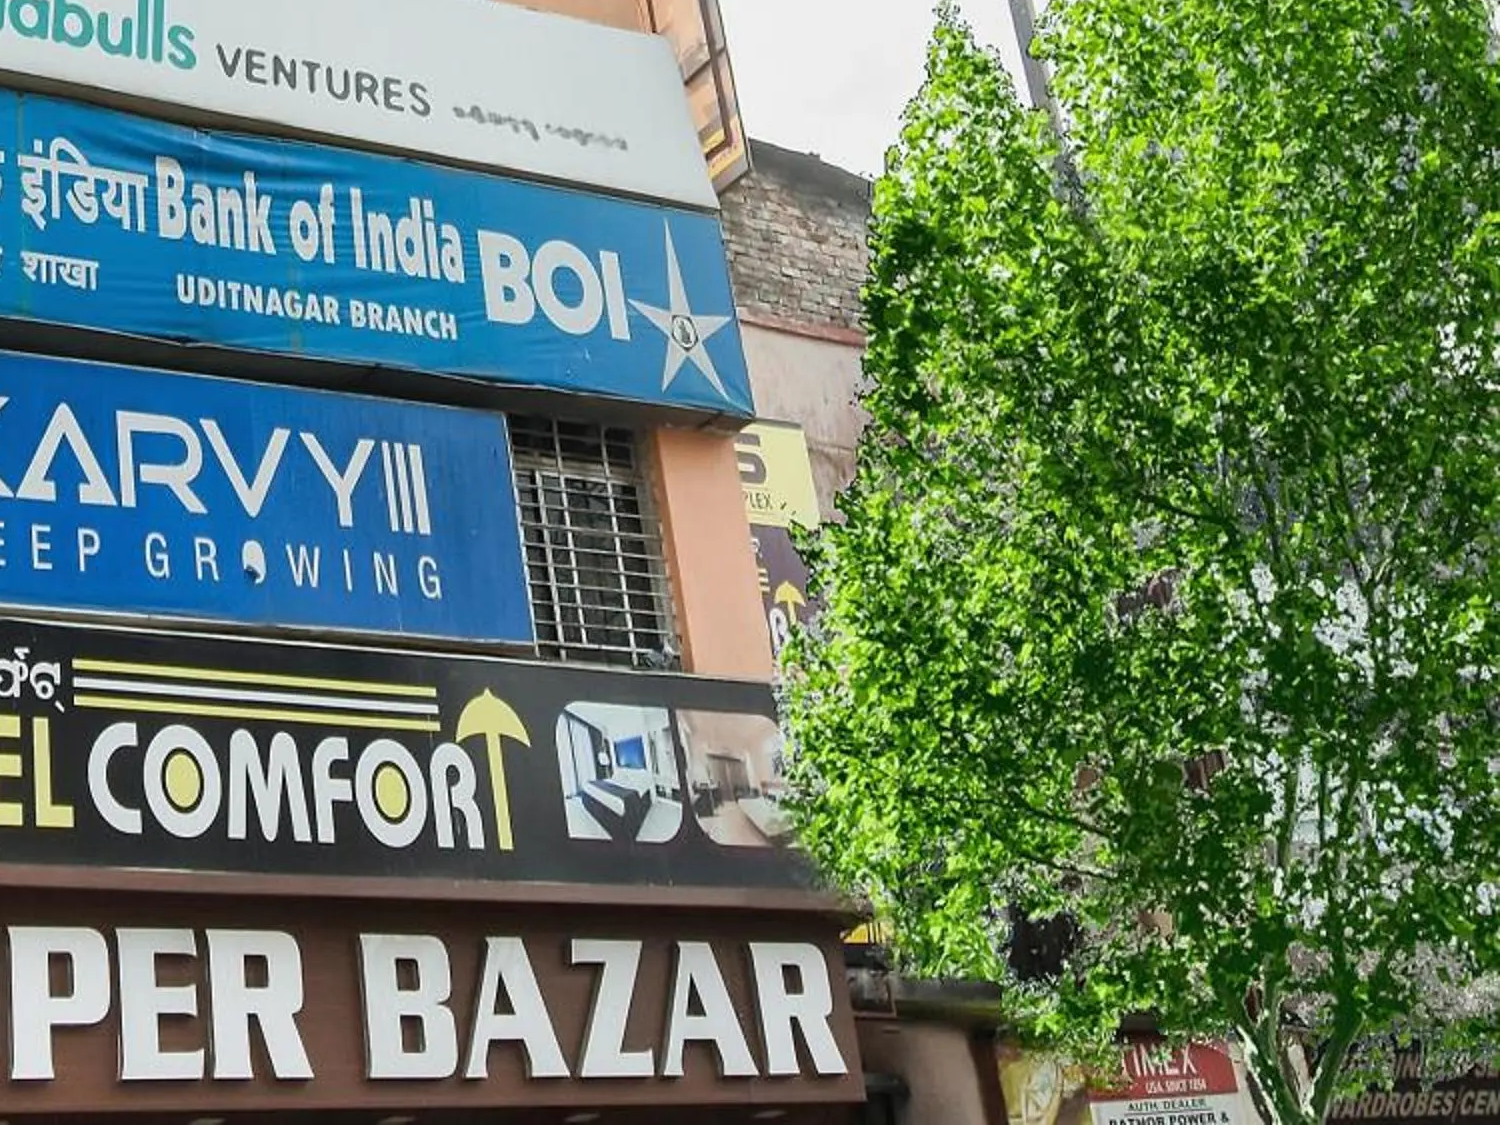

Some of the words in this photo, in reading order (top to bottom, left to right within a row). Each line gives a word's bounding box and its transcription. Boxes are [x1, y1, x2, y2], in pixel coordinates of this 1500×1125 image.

[215, 43, 431, 118] VENTURES
[17, 136, 149, 233] इंडिया
[155, 155, 276, 254] Bank
[289, 181, 336, 264] of
[350, 186, 466, 283] India
[20, 250, 99, 291] शाखा
[176, 274, 340, 324] UDITNAGAR
[349, 304, 458, 340] BRANCH
[476, 229, 632, 341] BOI
[144, 530, 444, 600] GROWING
[87, 687, 532, 851] COMFORT
[358, 931, 848, 1081] BAZAR
[1145, 1080, 1164, 1094] USA
[1165, 1079, 1187, 1092] SINCE
[1163, 1098, 1207, 1111] DEALER
